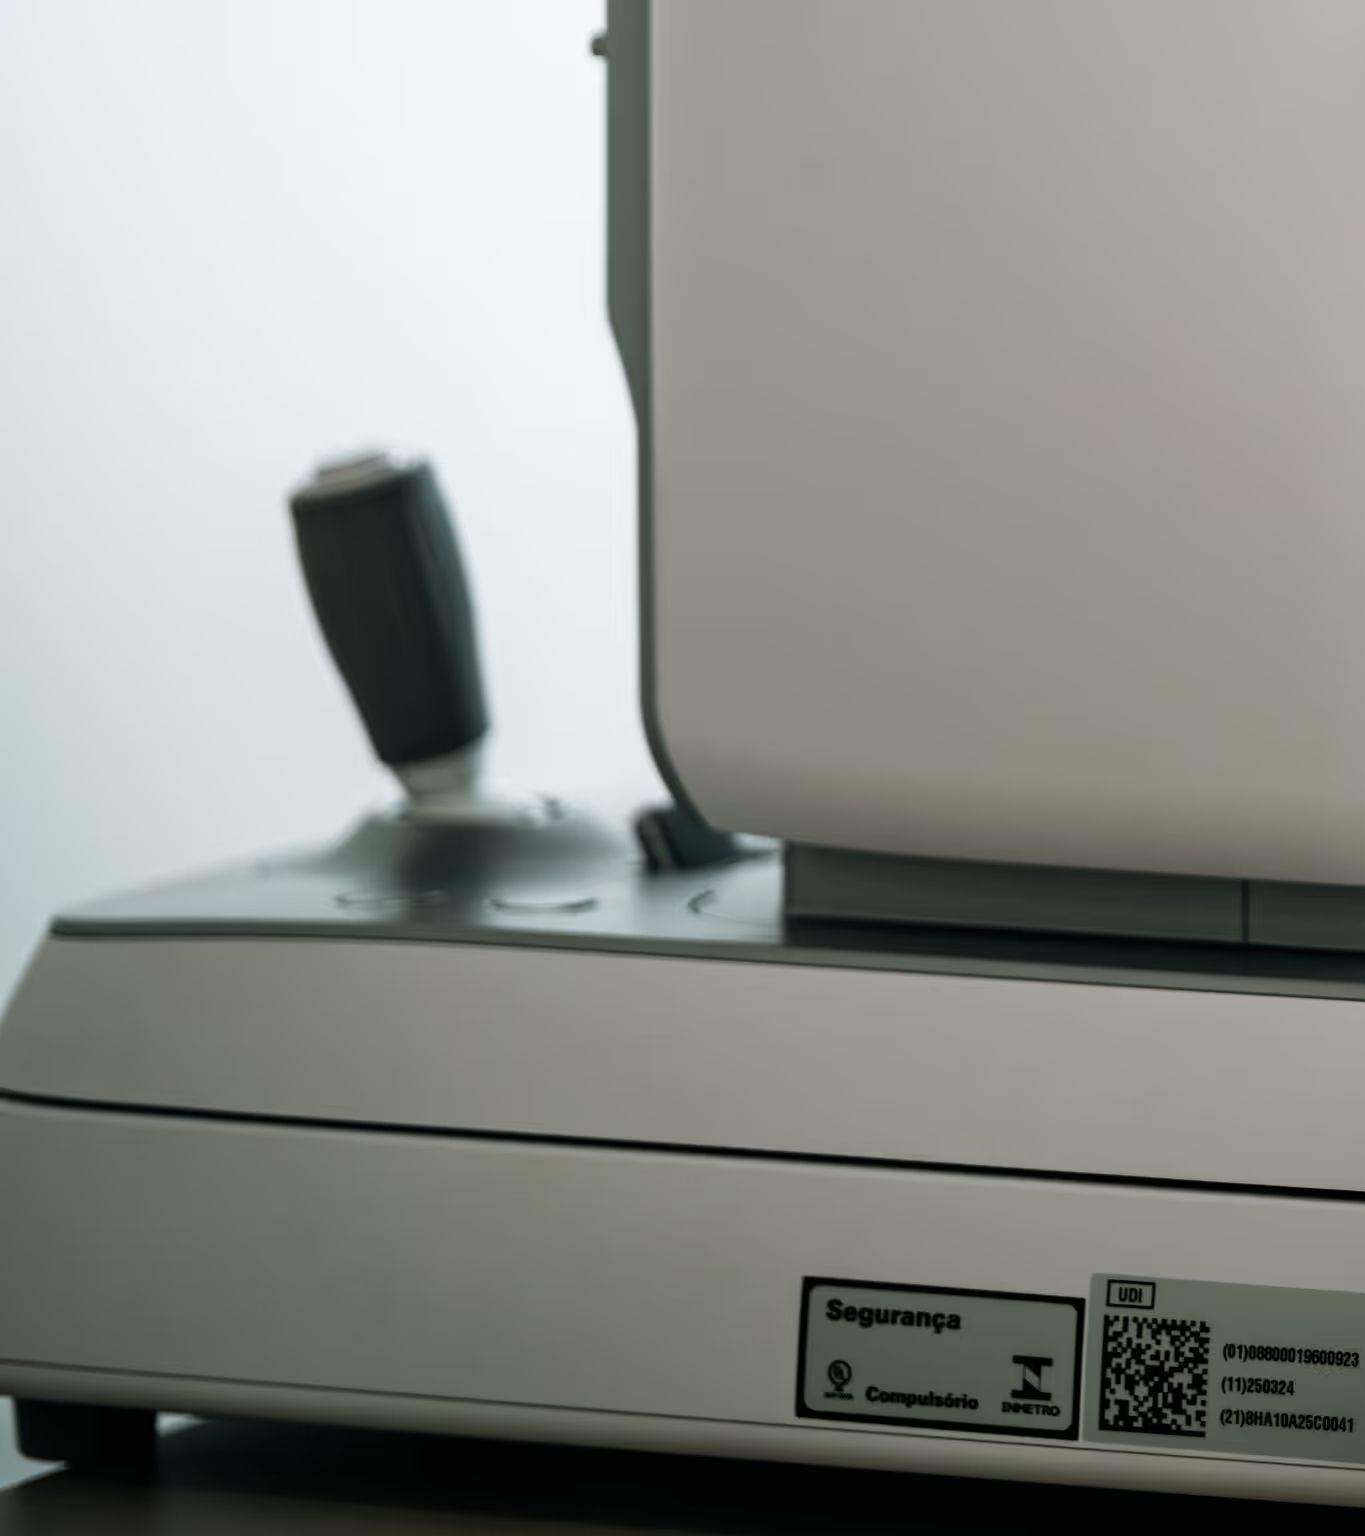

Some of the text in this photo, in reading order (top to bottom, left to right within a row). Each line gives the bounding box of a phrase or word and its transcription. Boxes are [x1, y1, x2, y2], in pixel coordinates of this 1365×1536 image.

[1118, 1287, 1143, 1303] UDI
[826, 1298, 961, 1334] Segurança
[1223, 1343, 1360, 1368] (01)08800019600923
[865, 1385, 979, 1411] Compulsório
[1221, 1377, 1295, 1396] (11)250324
[1001, 1401, 1061, 1417] INMETRO
[1220, 1408, 1354, 1433] (21)8HA10A25C0041
